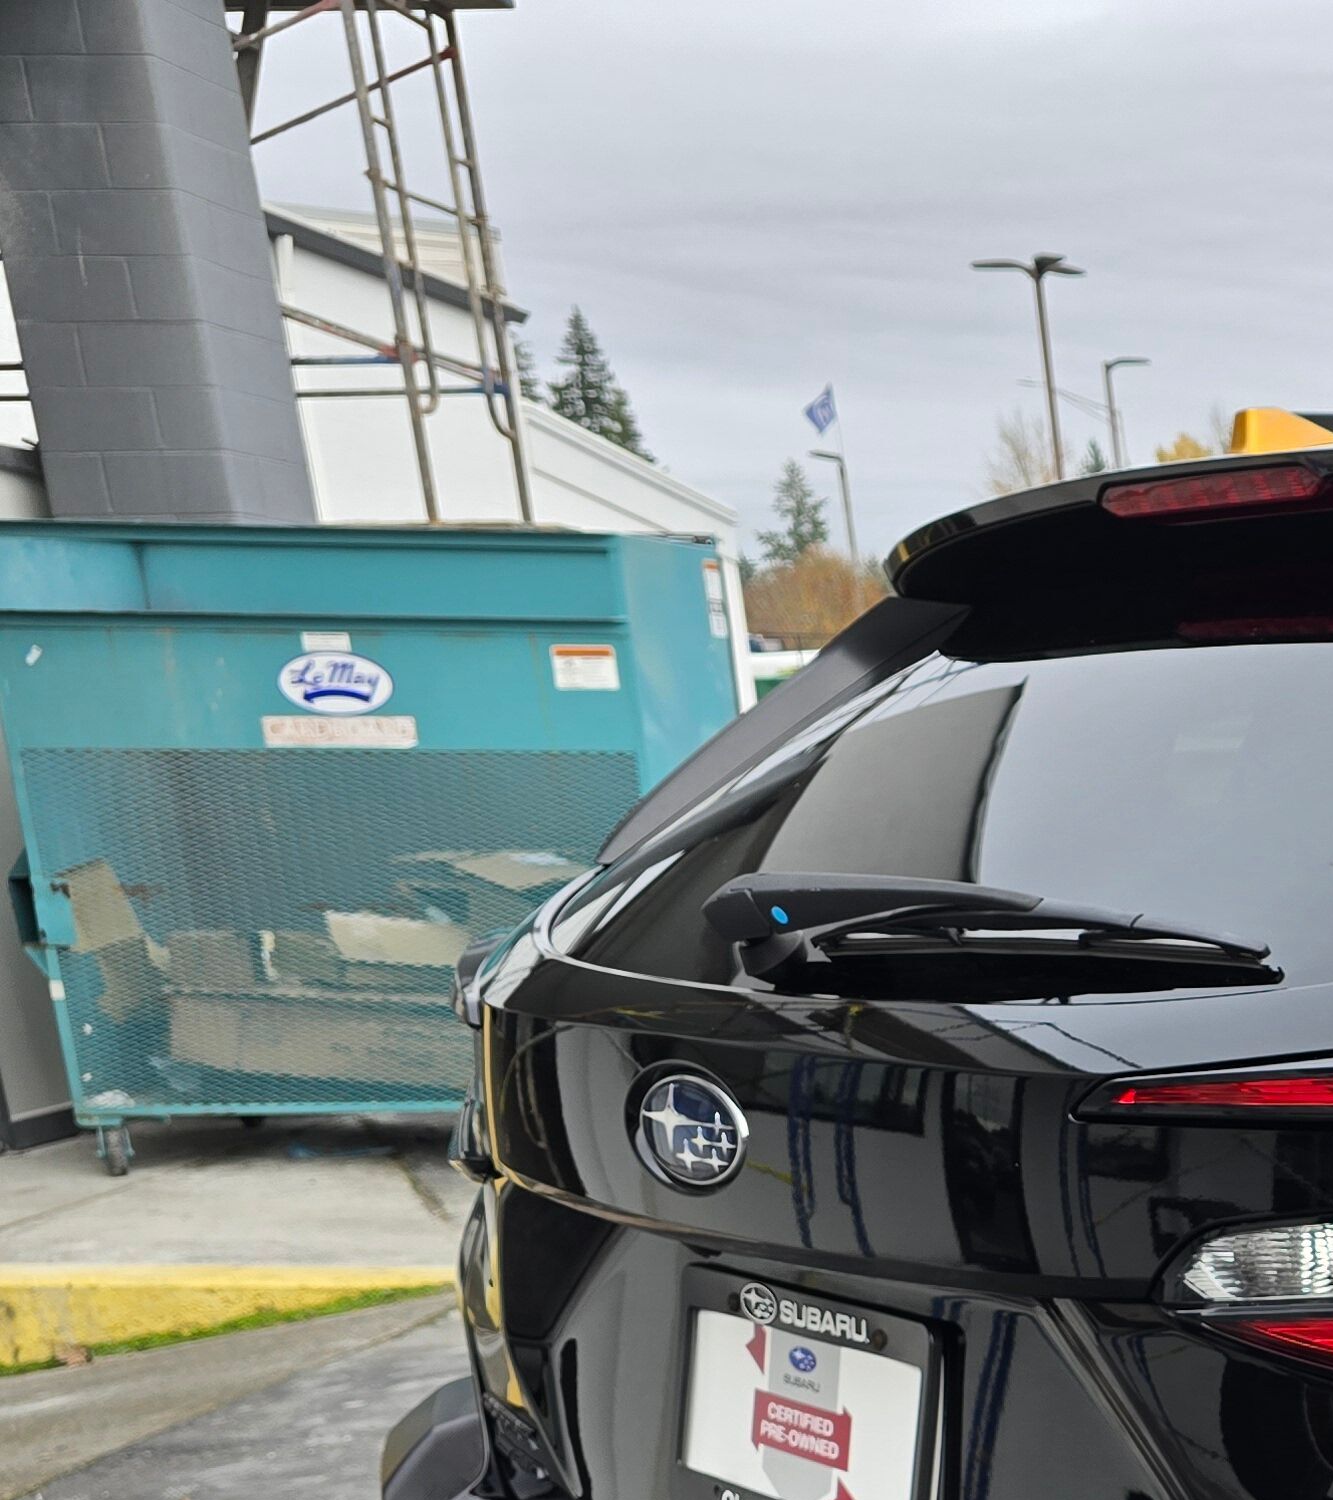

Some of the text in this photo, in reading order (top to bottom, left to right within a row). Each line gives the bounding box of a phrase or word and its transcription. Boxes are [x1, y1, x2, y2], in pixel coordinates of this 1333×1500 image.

[779, 1299, 868, 1343] SUBARU
[783, 1373, 821, 1392] SUBARU
[767, 1401, 834, 1437] CERTIFIED
[760, 1418, 840, 1460] PRE-OWNED
